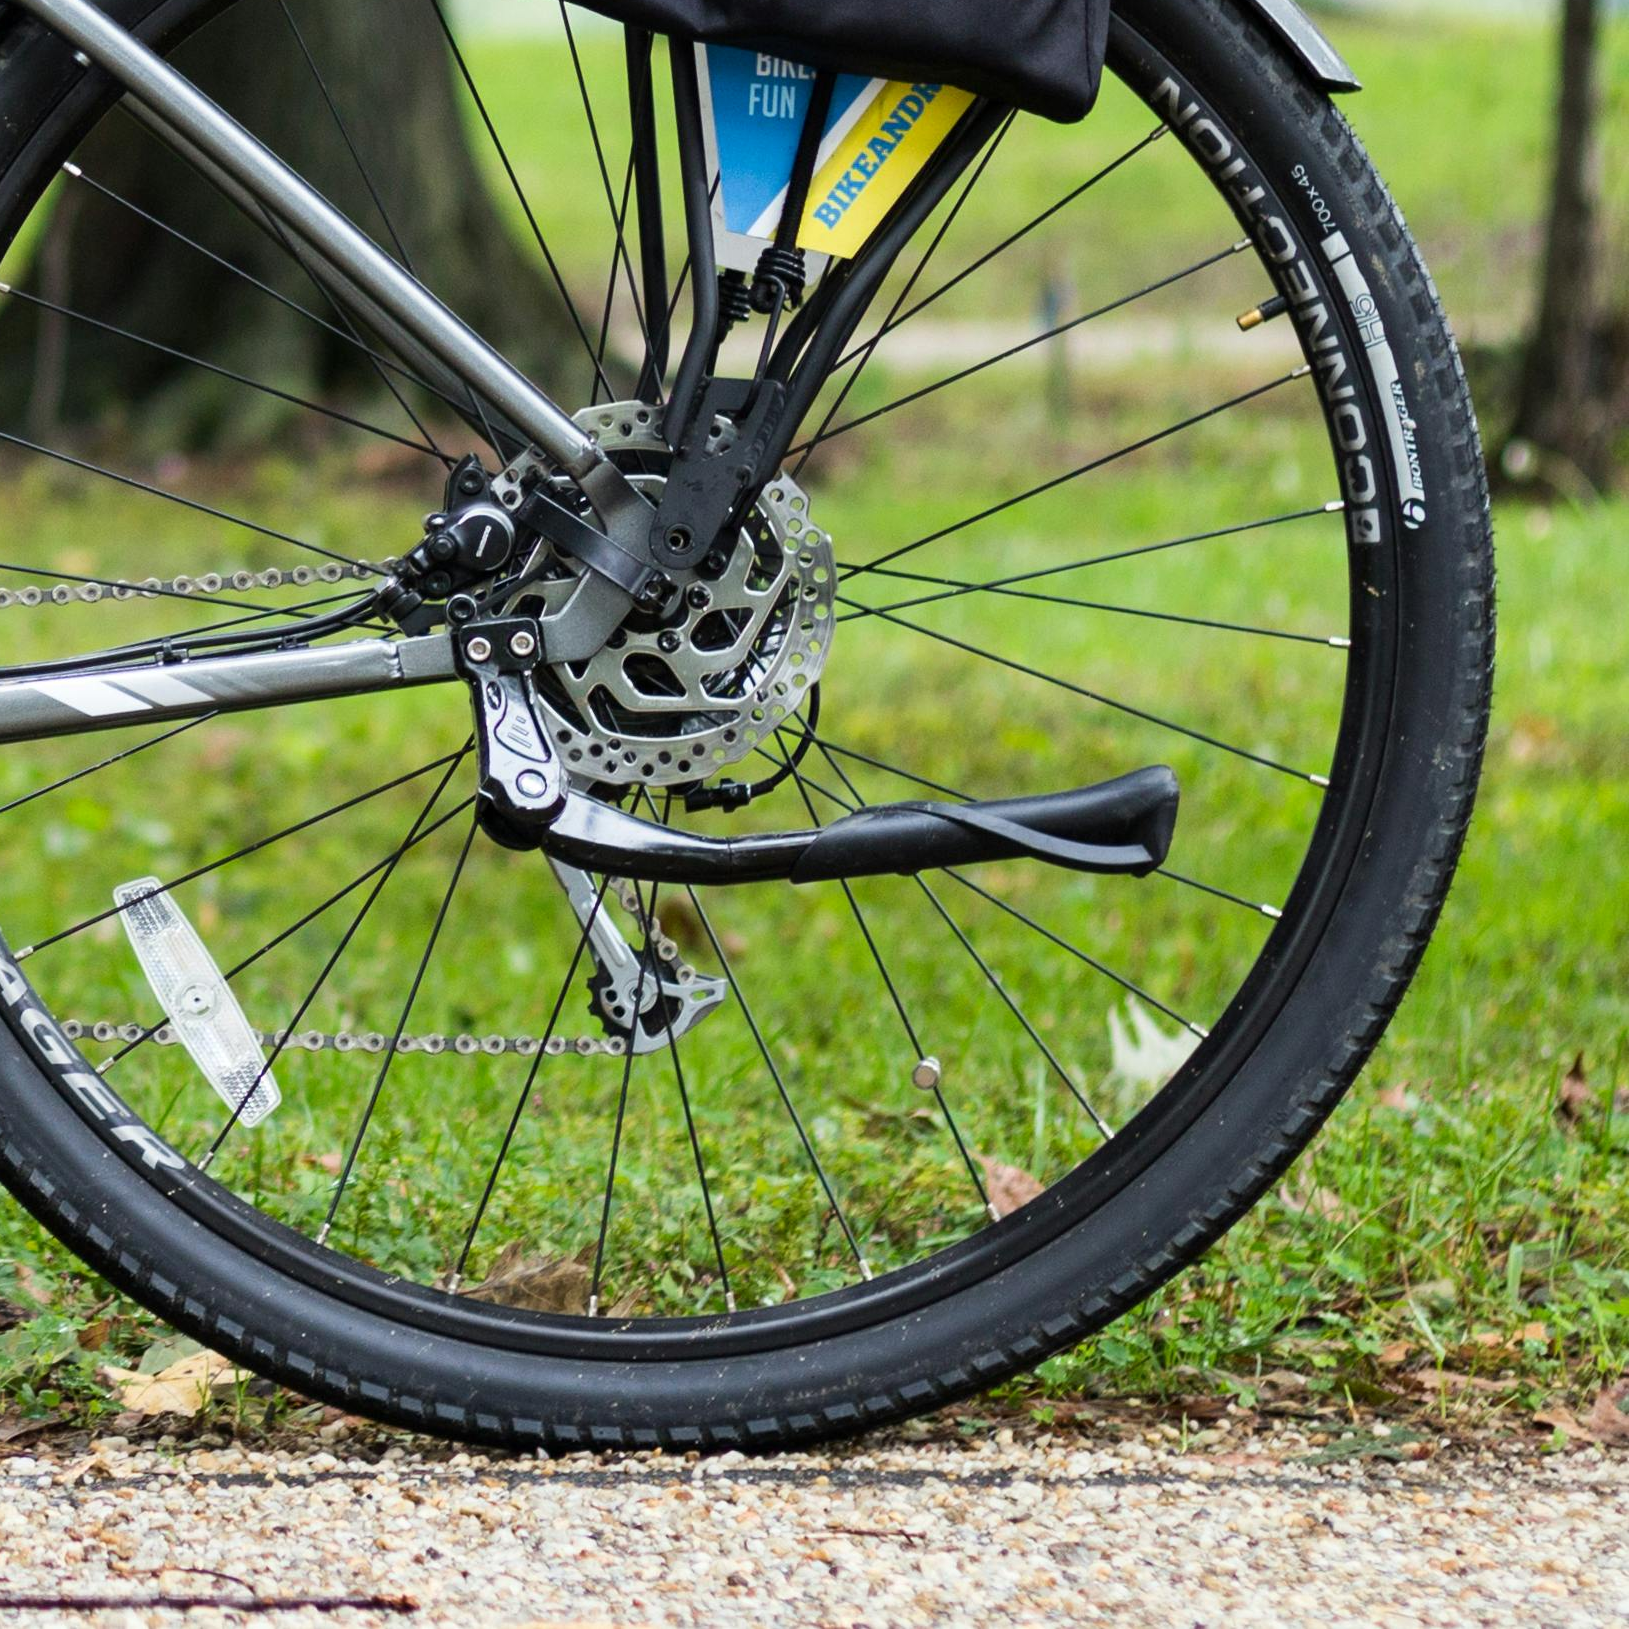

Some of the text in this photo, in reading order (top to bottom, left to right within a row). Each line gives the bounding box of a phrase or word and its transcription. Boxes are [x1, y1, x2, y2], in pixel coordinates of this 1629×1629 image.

[749, 83, 795, 119] FUN
[1291, 164, 1336, 233] 700x45
[1151, 76, 1376, 505] CONNECTION
[1392, 382, 1424, 490] BONTRGER
